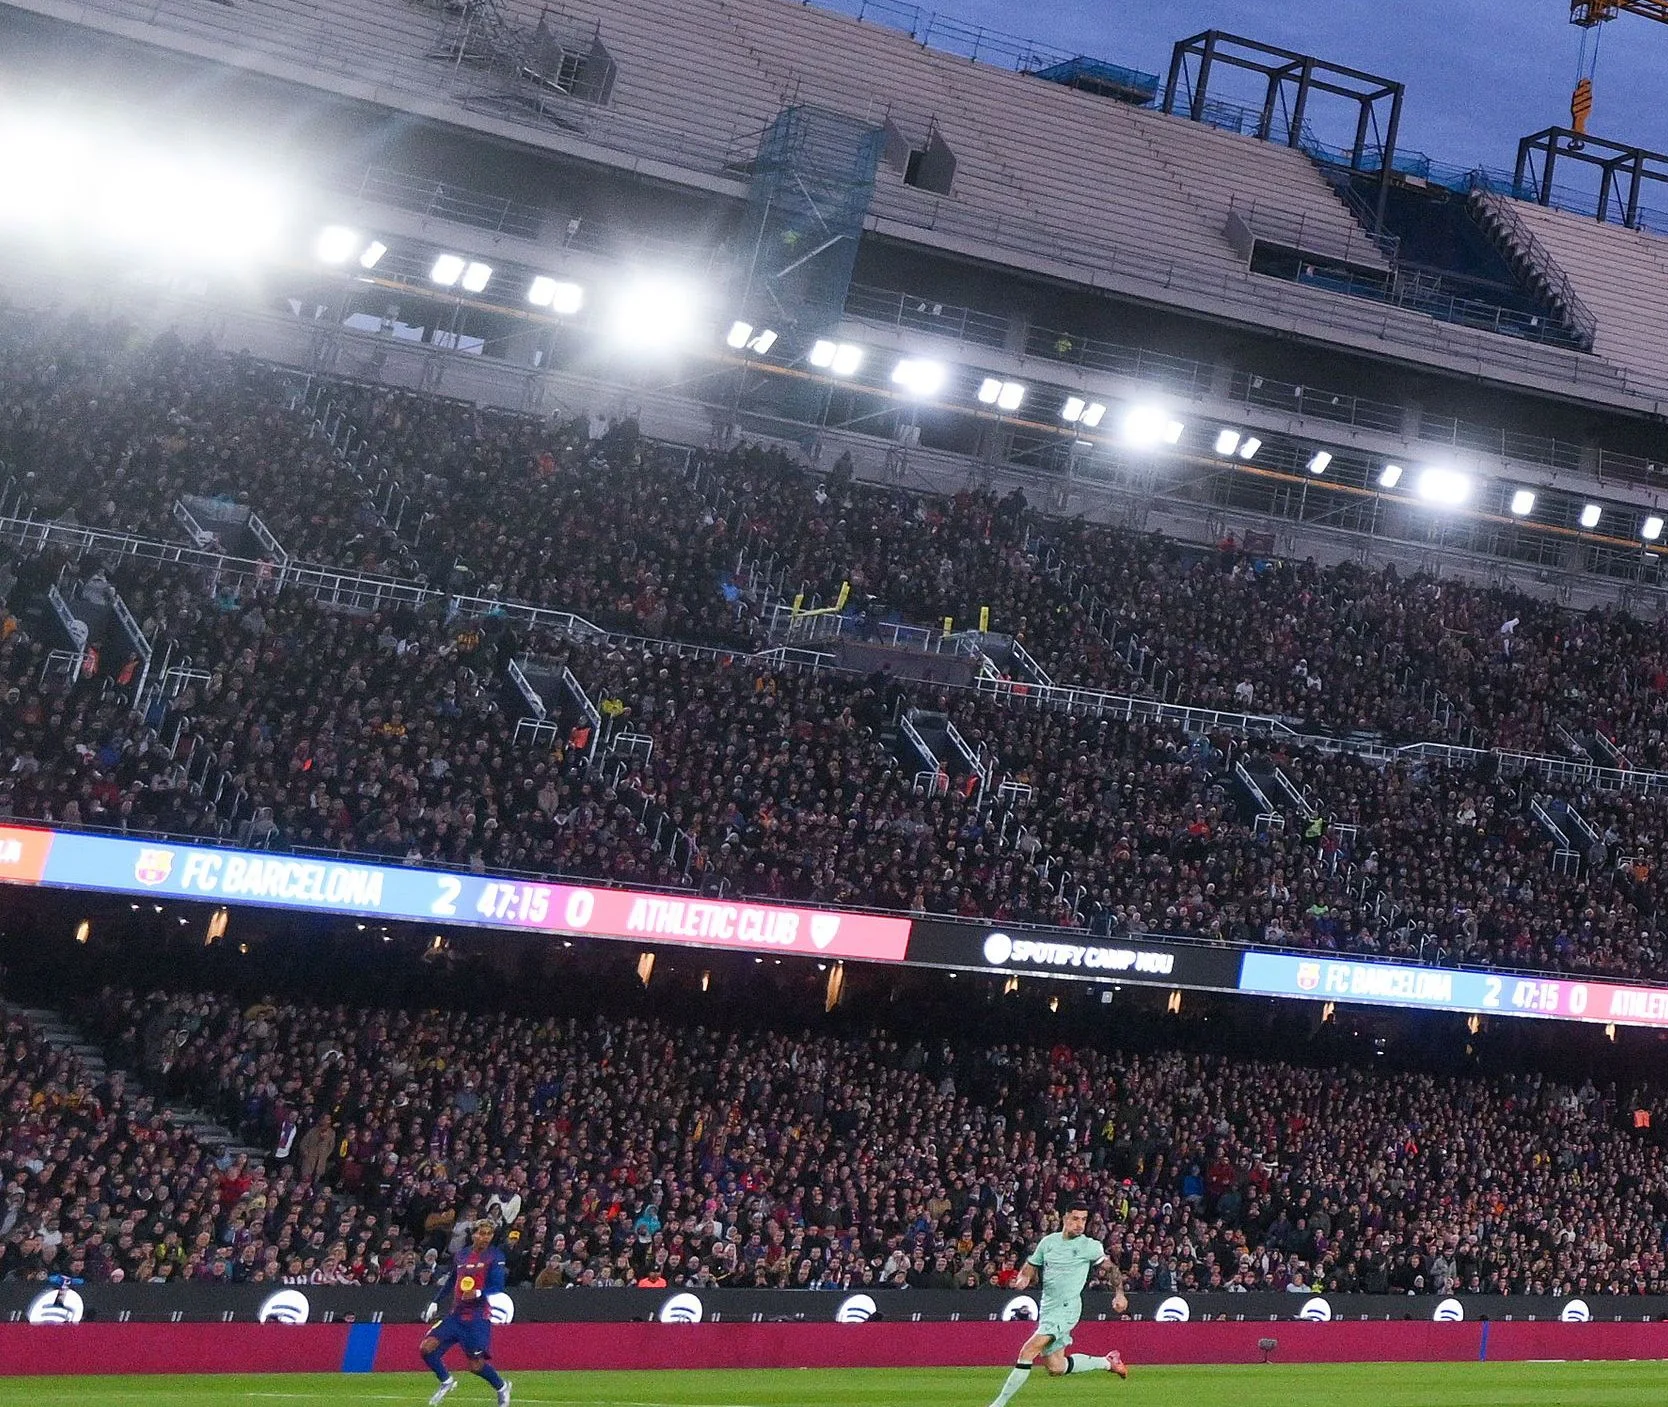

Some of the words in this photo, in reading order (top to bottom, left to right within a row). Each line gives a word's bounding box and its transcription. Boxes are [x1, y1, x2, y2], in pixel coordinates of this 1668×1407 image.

[180, 852, 223, 891] FC
[221, 856, 384, 907] BARCELONA
[431, 876, 462, 917] 2
[476, 882, 551, 923] 47:15
[566, 889, 595, 928] 0
[626, 897, 738, 939] ATHLETIC
[737, 908, 800, 945] CLUB
[1010, 939, 1087, 966] SPOTIFY
[1084, 946, 1137, 970] CAMP
[1135, 951, 1175, 974] NOU
[1325, 963, 1351, 993] FC
[1351, 965, 1452, 1003] BARCELONA
[1483, 975, 1502, 1008] 2
[1568, 984, 1588, 1014] 0
